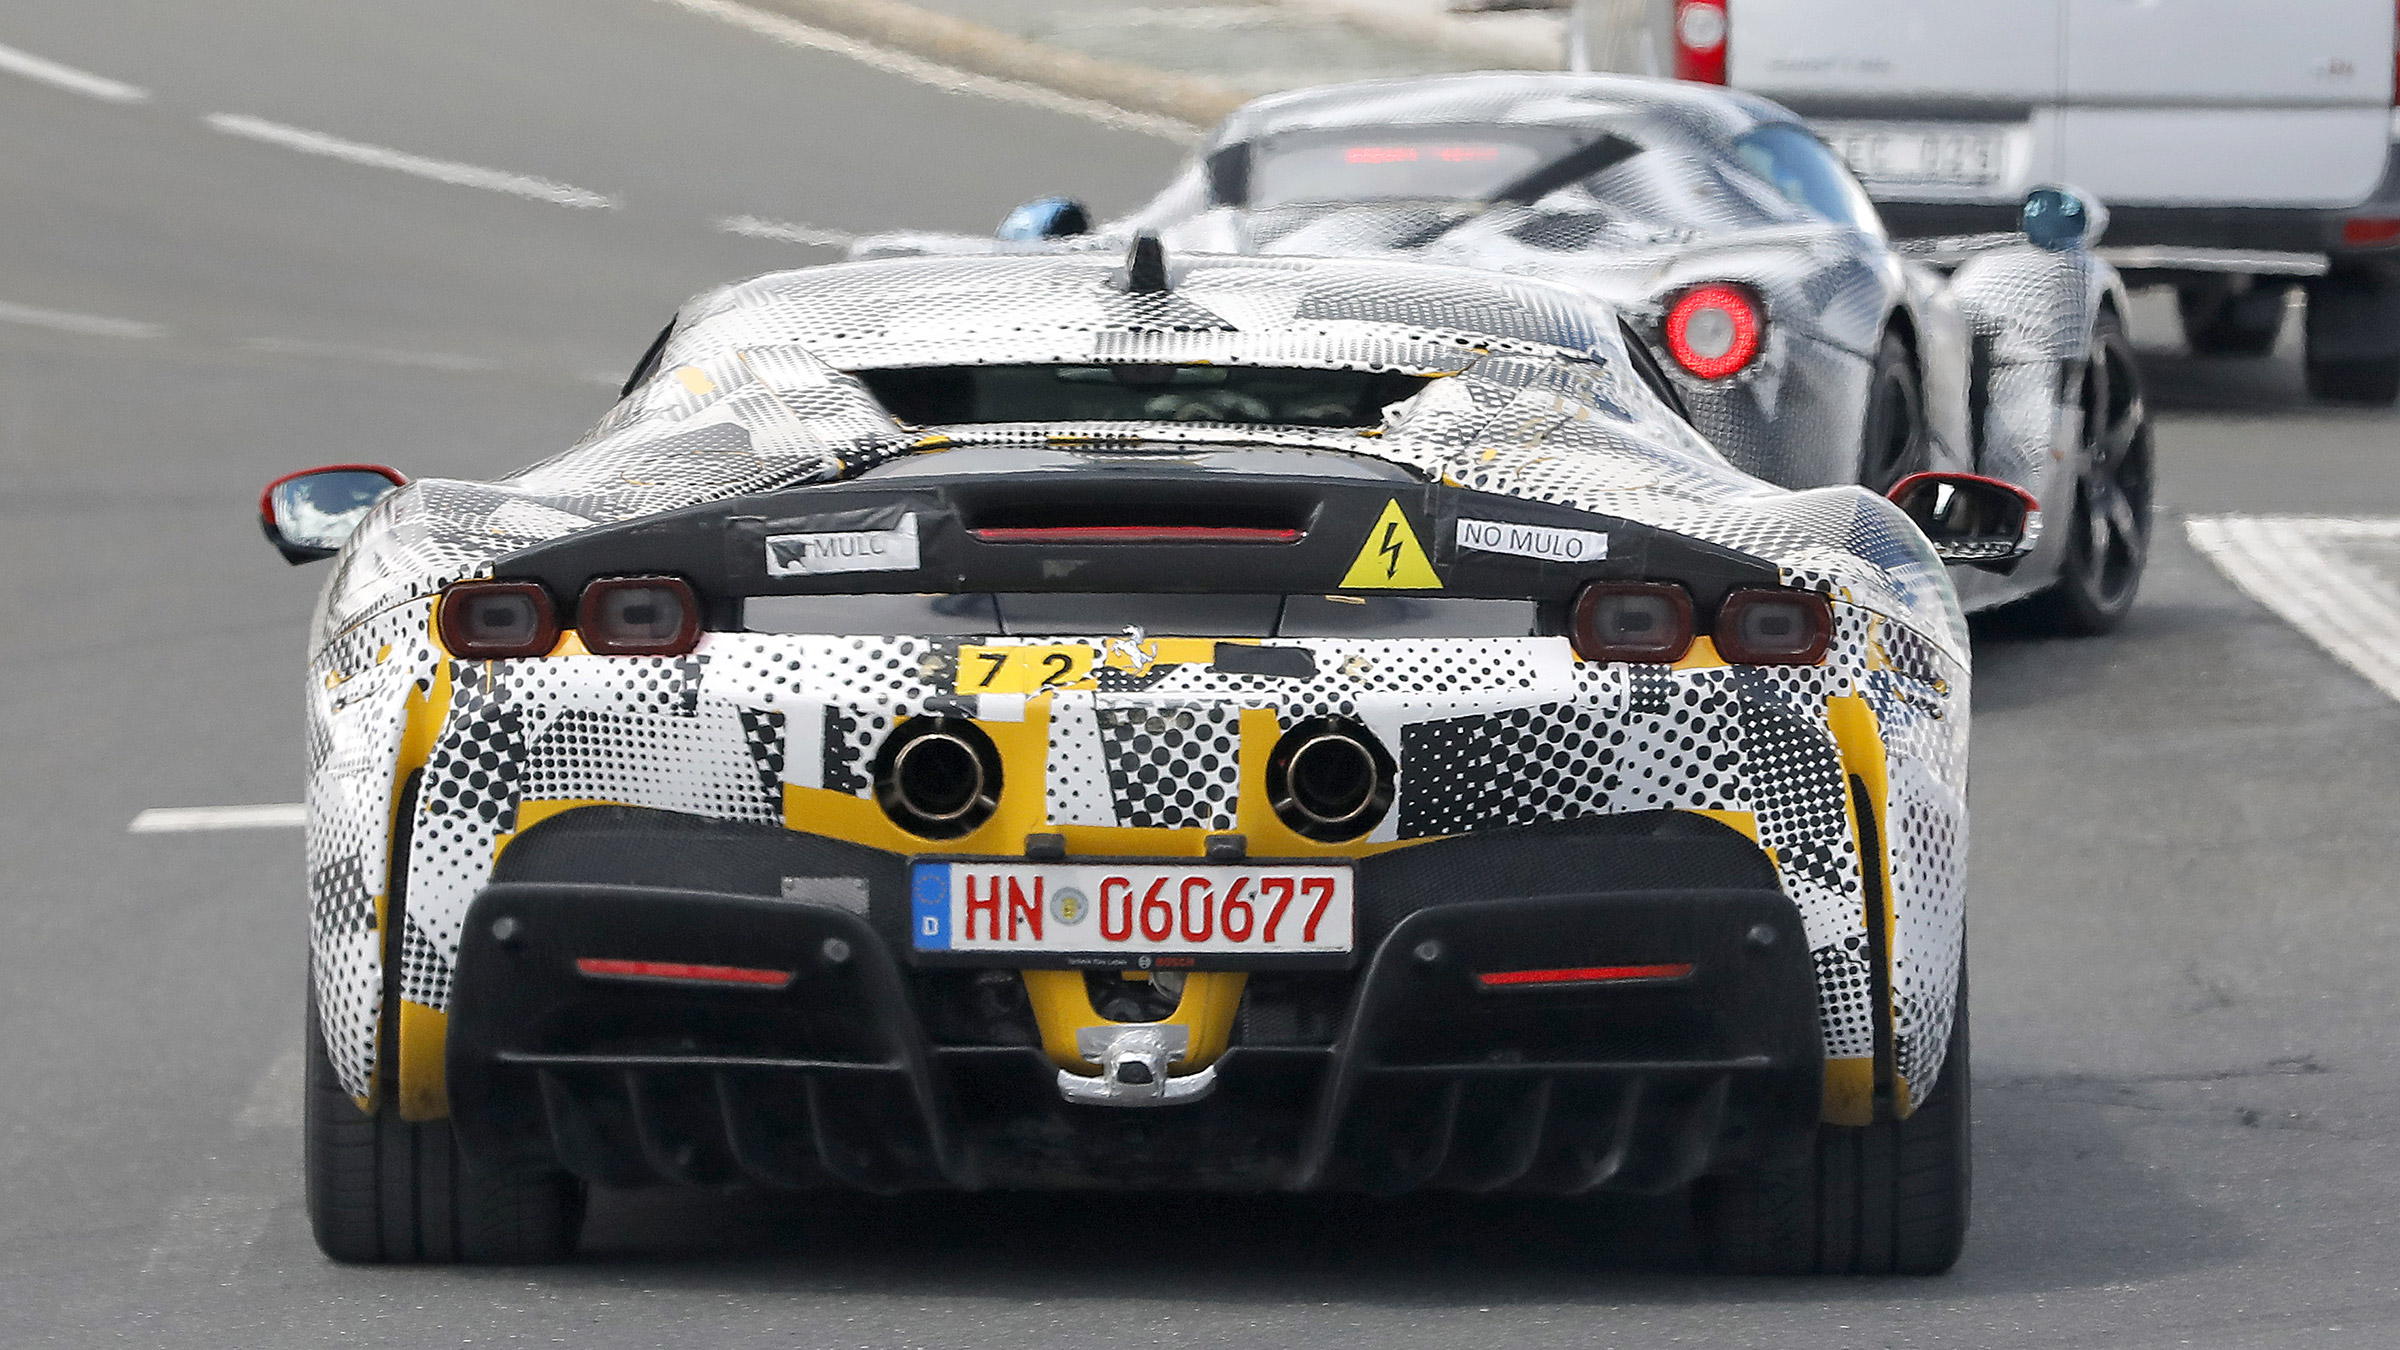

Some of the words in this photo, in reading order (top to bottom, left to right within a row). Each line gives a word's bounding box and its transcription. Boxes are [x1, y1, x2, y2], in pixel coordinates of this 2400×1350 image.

[1464, 523, 1501, 548] NO
[1509, 529, 1583, 559] MULO
[965, 874, 1044, 942] HN
[1099, 876, 1336, 943] 060677
[921, 917, 939, 936] D
[1155, 957, 1195, 967] BOSCH
